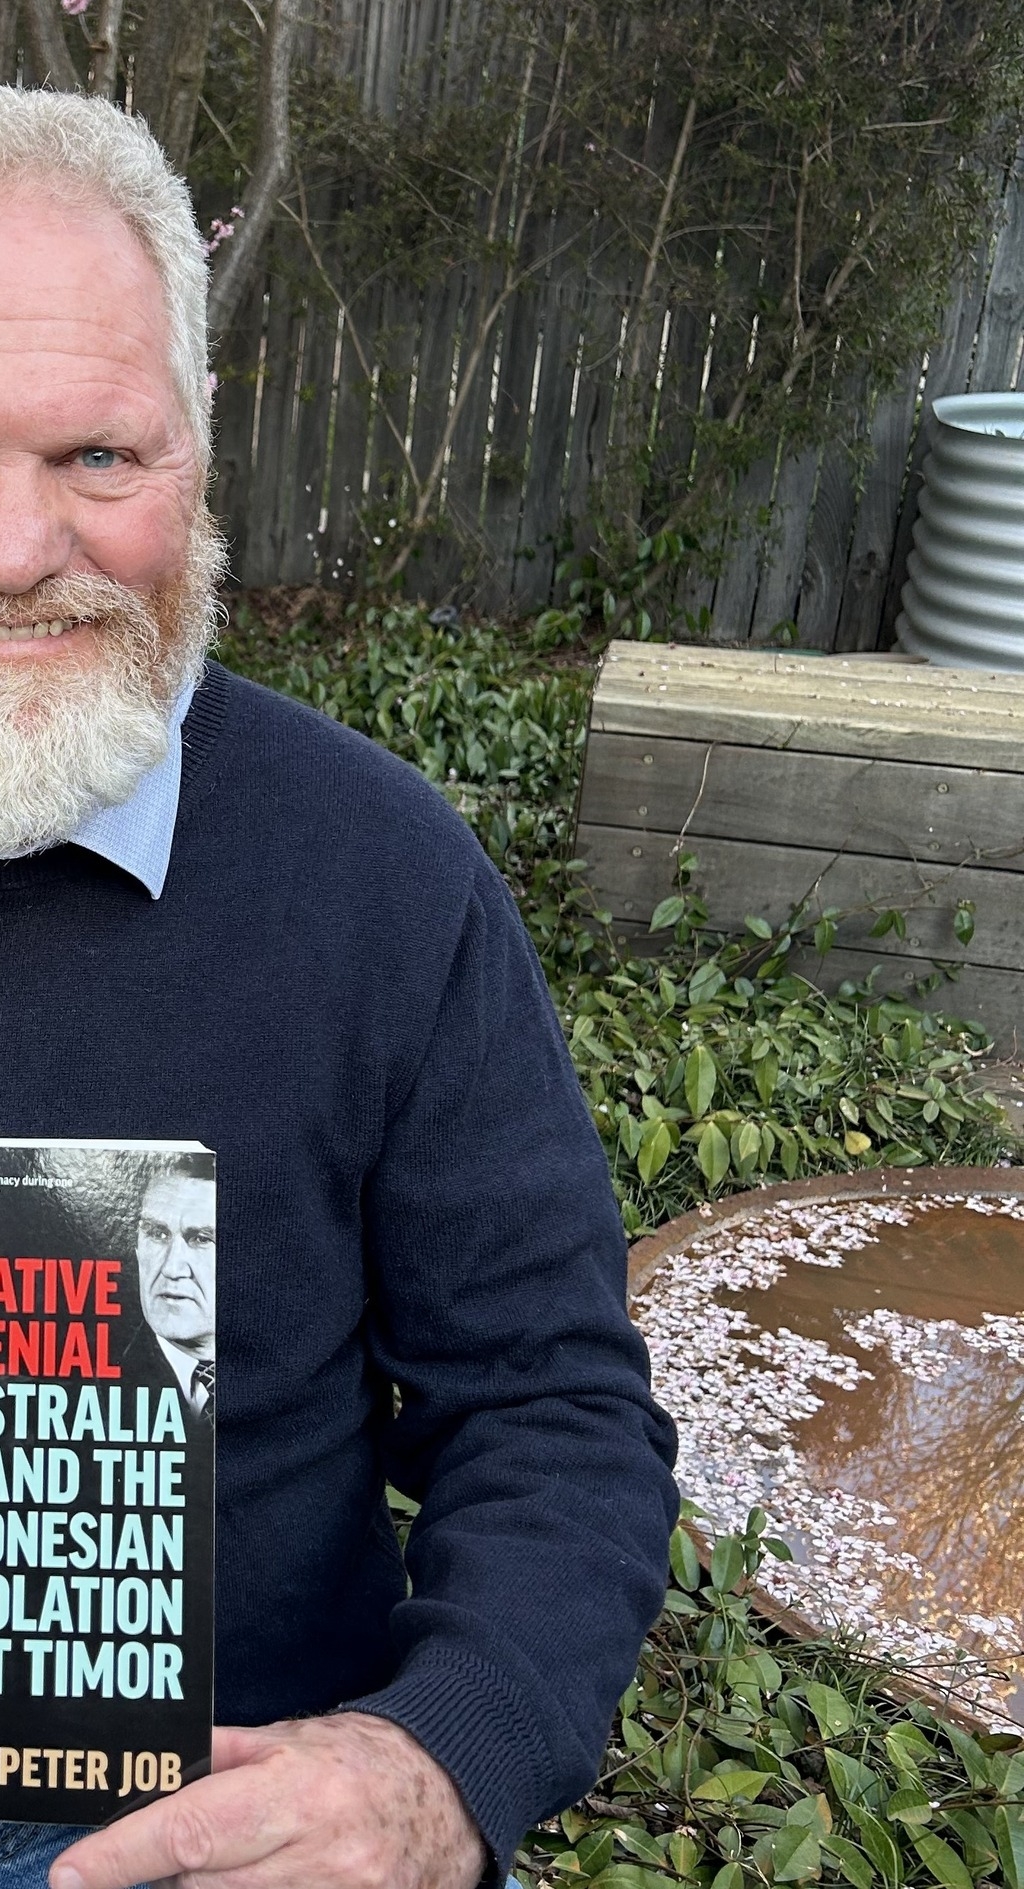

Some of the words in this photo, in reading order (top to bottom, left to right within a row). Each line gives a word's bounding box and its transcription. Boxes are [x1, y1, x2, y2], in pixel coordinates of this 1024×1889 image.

[22, 1174, 54, 1188] during
[55, 1178, 73, 1187] one
[93, 1449, 185, 1507] THE
[23, 1640, 184, 1700] TIMOR
[118, 1751, 182, 1797] JOB
